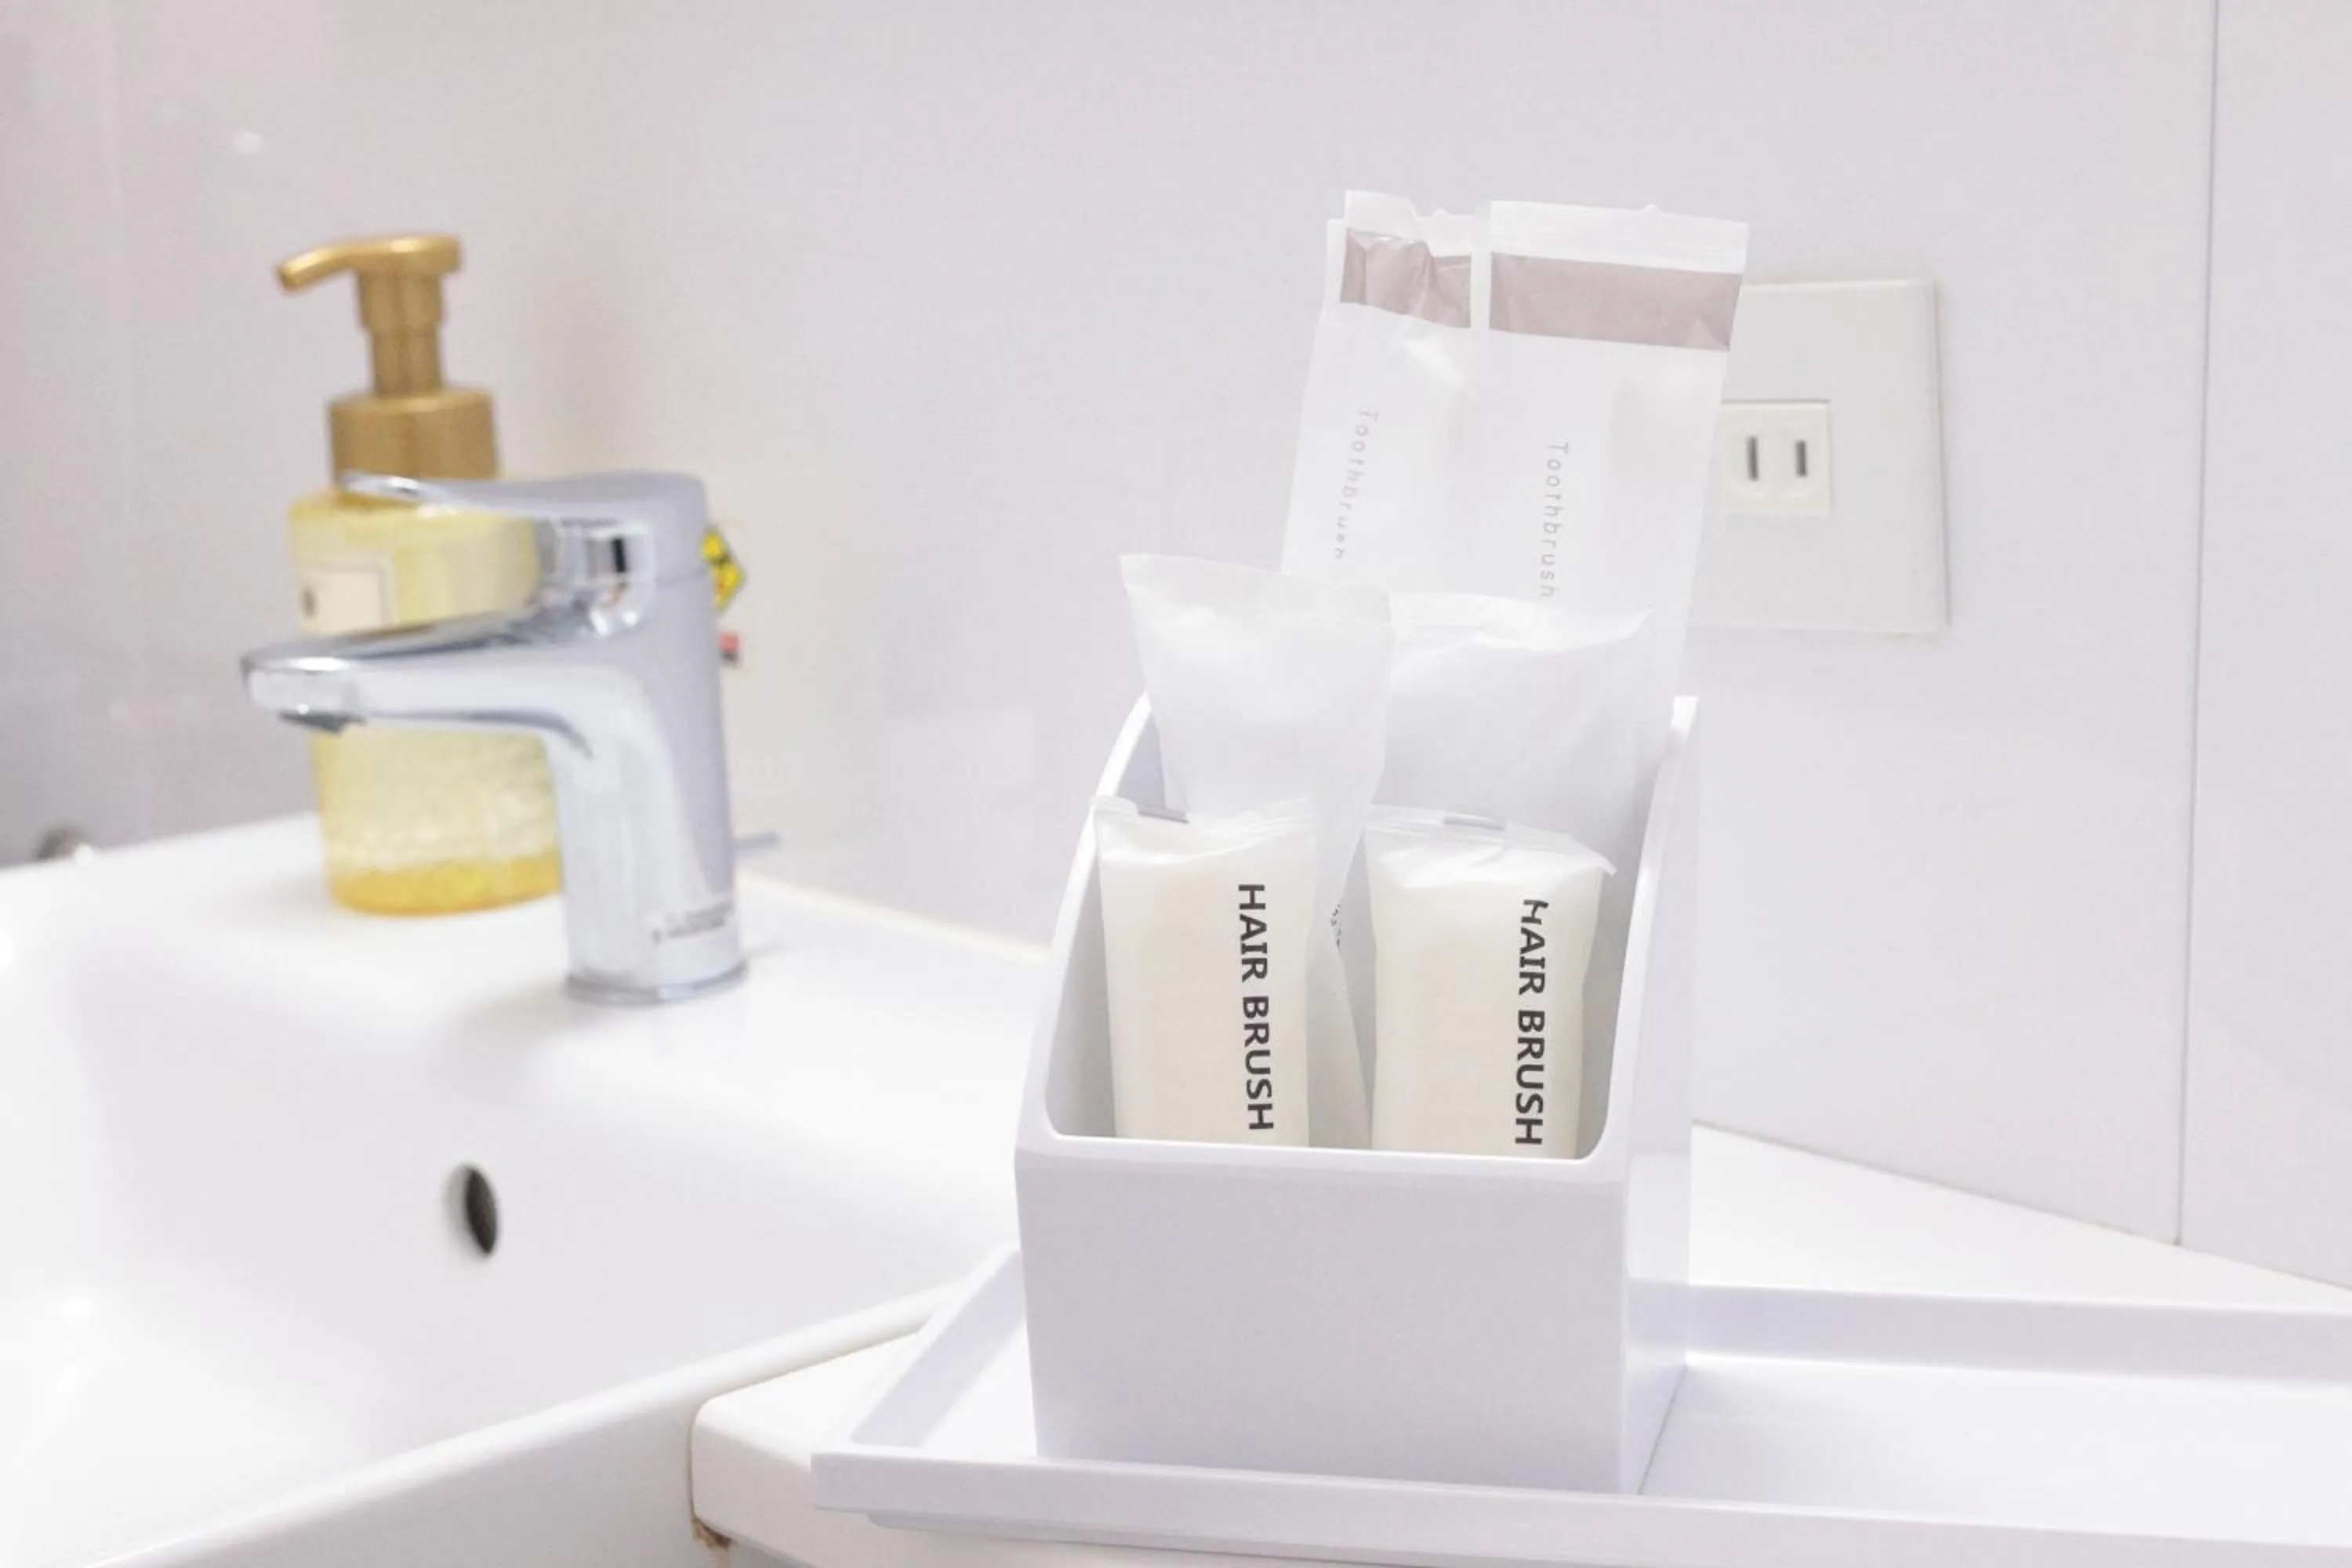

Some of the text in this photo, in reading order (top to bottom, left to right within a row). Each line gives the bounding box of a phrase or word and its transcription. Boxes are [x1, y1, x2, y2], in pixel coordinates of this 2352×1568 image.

[1539, 441, 1568, 598] Toothbrush
[1238, 884, 1274, 1130] HAIR BRUSH
[1515, 899, 1549, 1145] HAIR BRUSH
